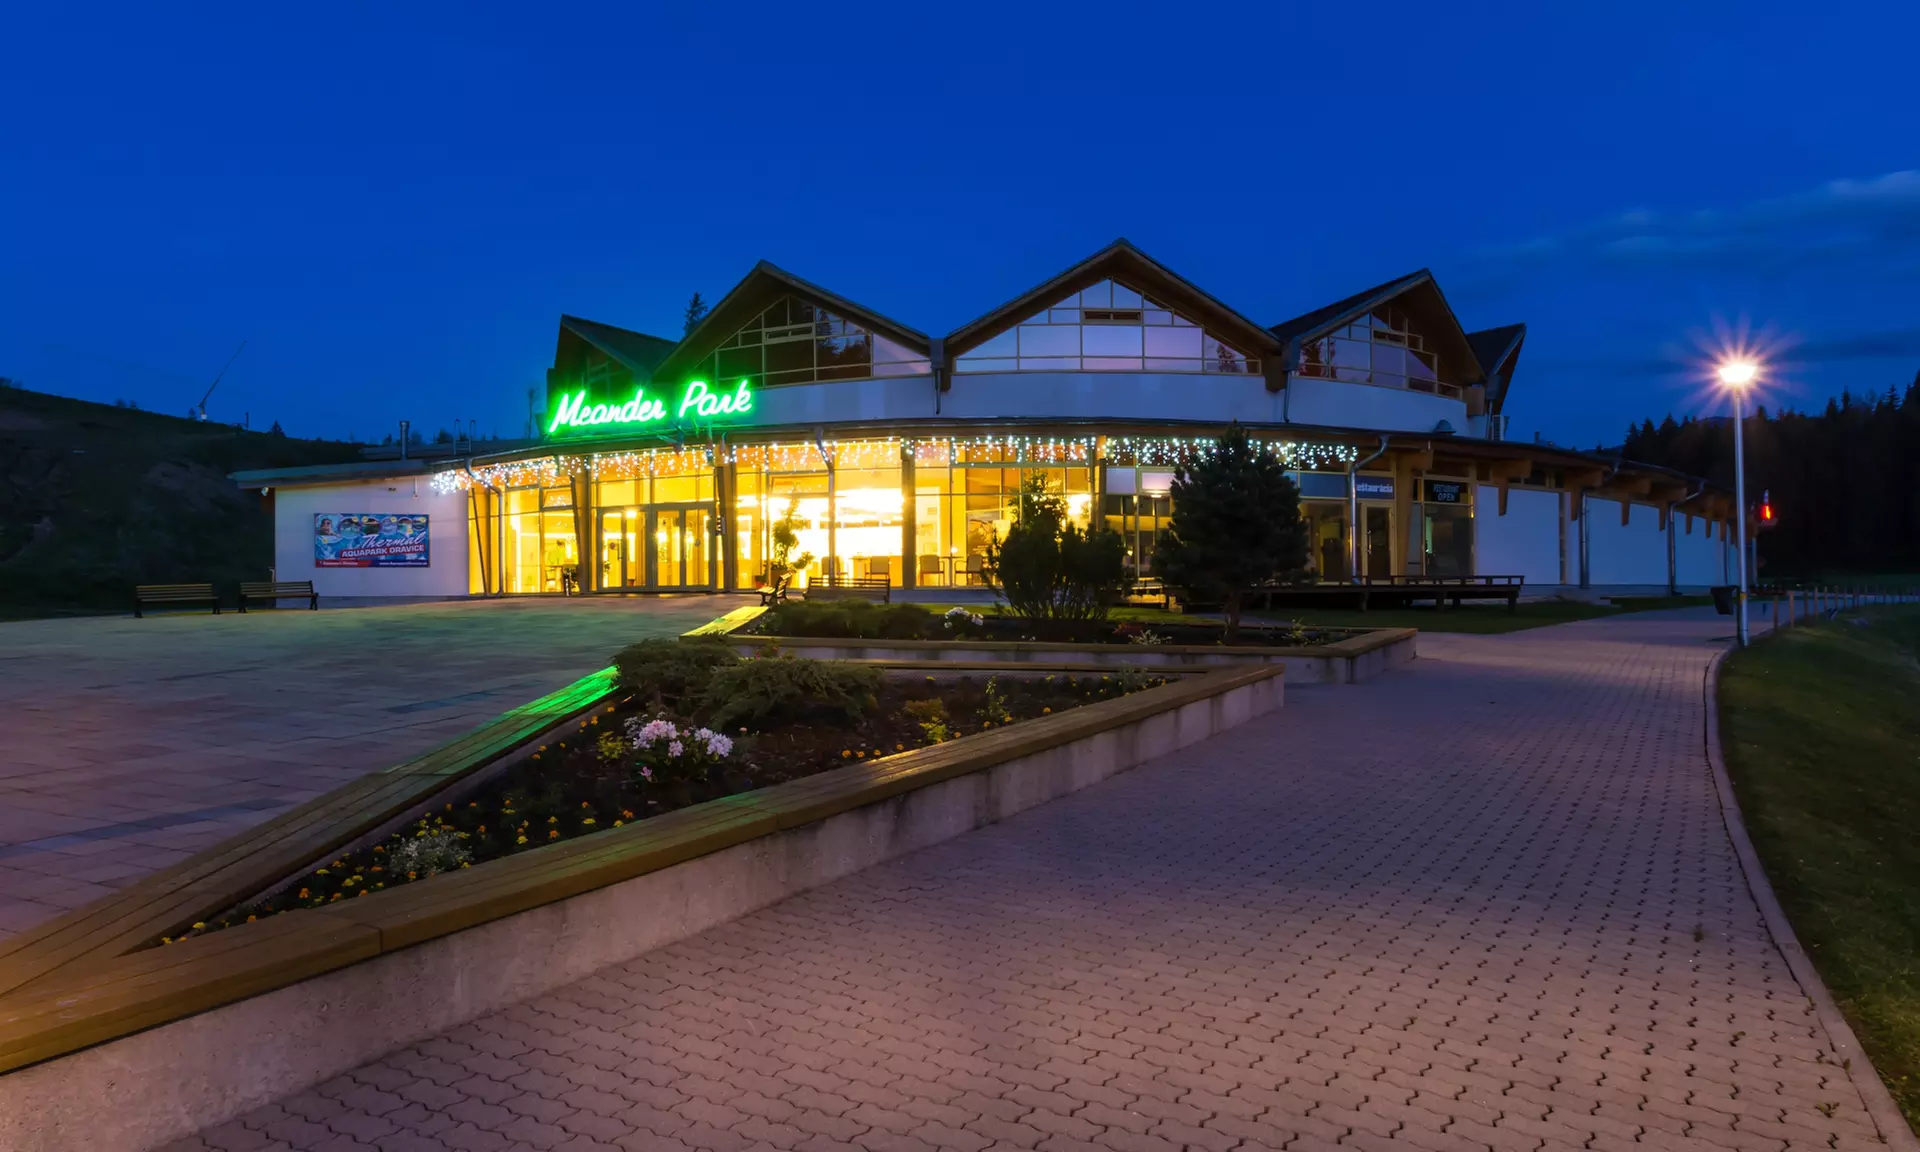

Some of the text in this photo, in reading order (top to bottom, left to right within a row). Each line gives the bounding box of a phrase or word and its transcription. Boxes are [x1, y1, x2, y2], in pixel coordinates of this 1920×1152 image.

[549, 379, 753, 433] Meander Park
[1437, 493, 1455, 501] OPEN
[361, 531, 427, 549] Thermal
[342, 545, 425, 558] AQUAPARK ORAVICE
